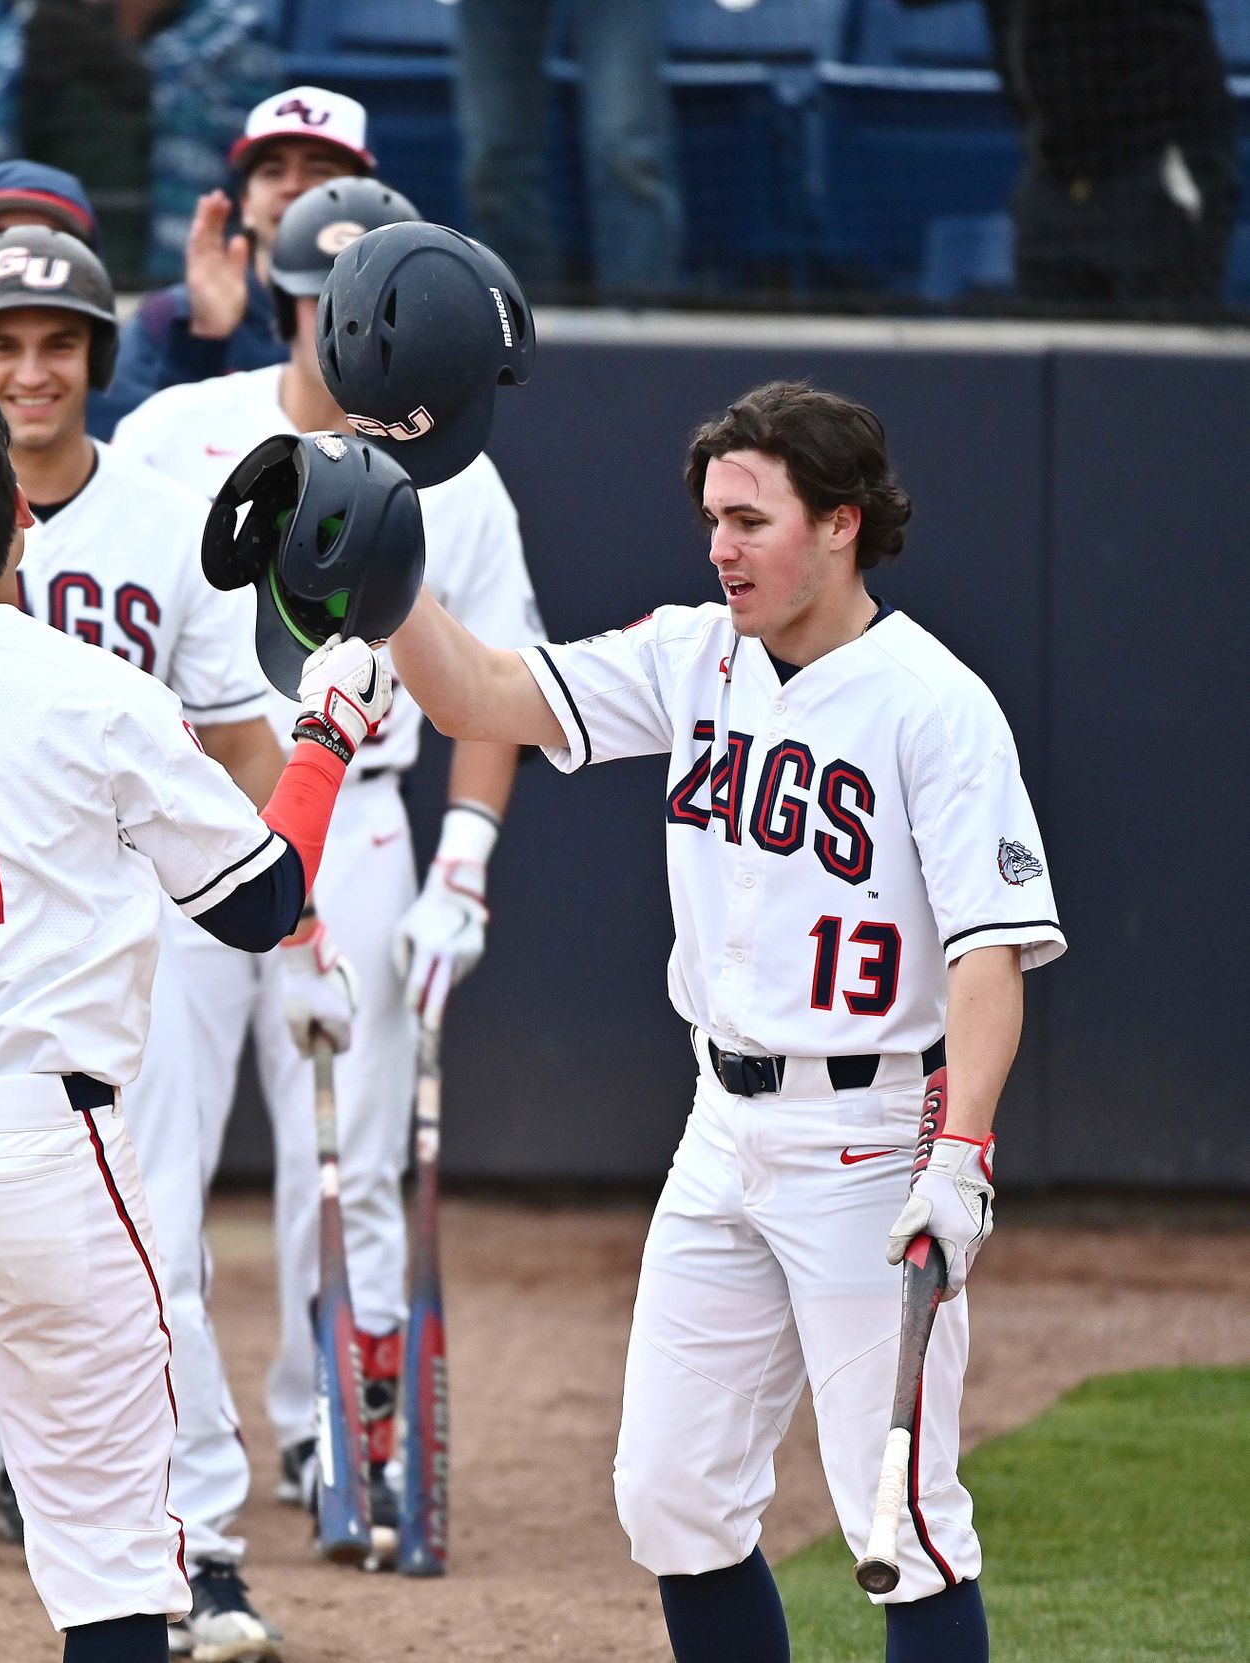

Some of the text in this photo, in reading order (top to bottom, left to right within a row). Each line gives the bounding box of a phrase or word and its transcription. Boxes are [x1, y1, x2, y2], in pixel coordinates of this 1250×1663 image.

[489, 287, 513, 347] marucci
[346, 405, 435, 441] GU
[16, 569, 161, 675] GS
[666, 719, 876, 886] ZAGS
[808, 914, 902, 1017] 13
